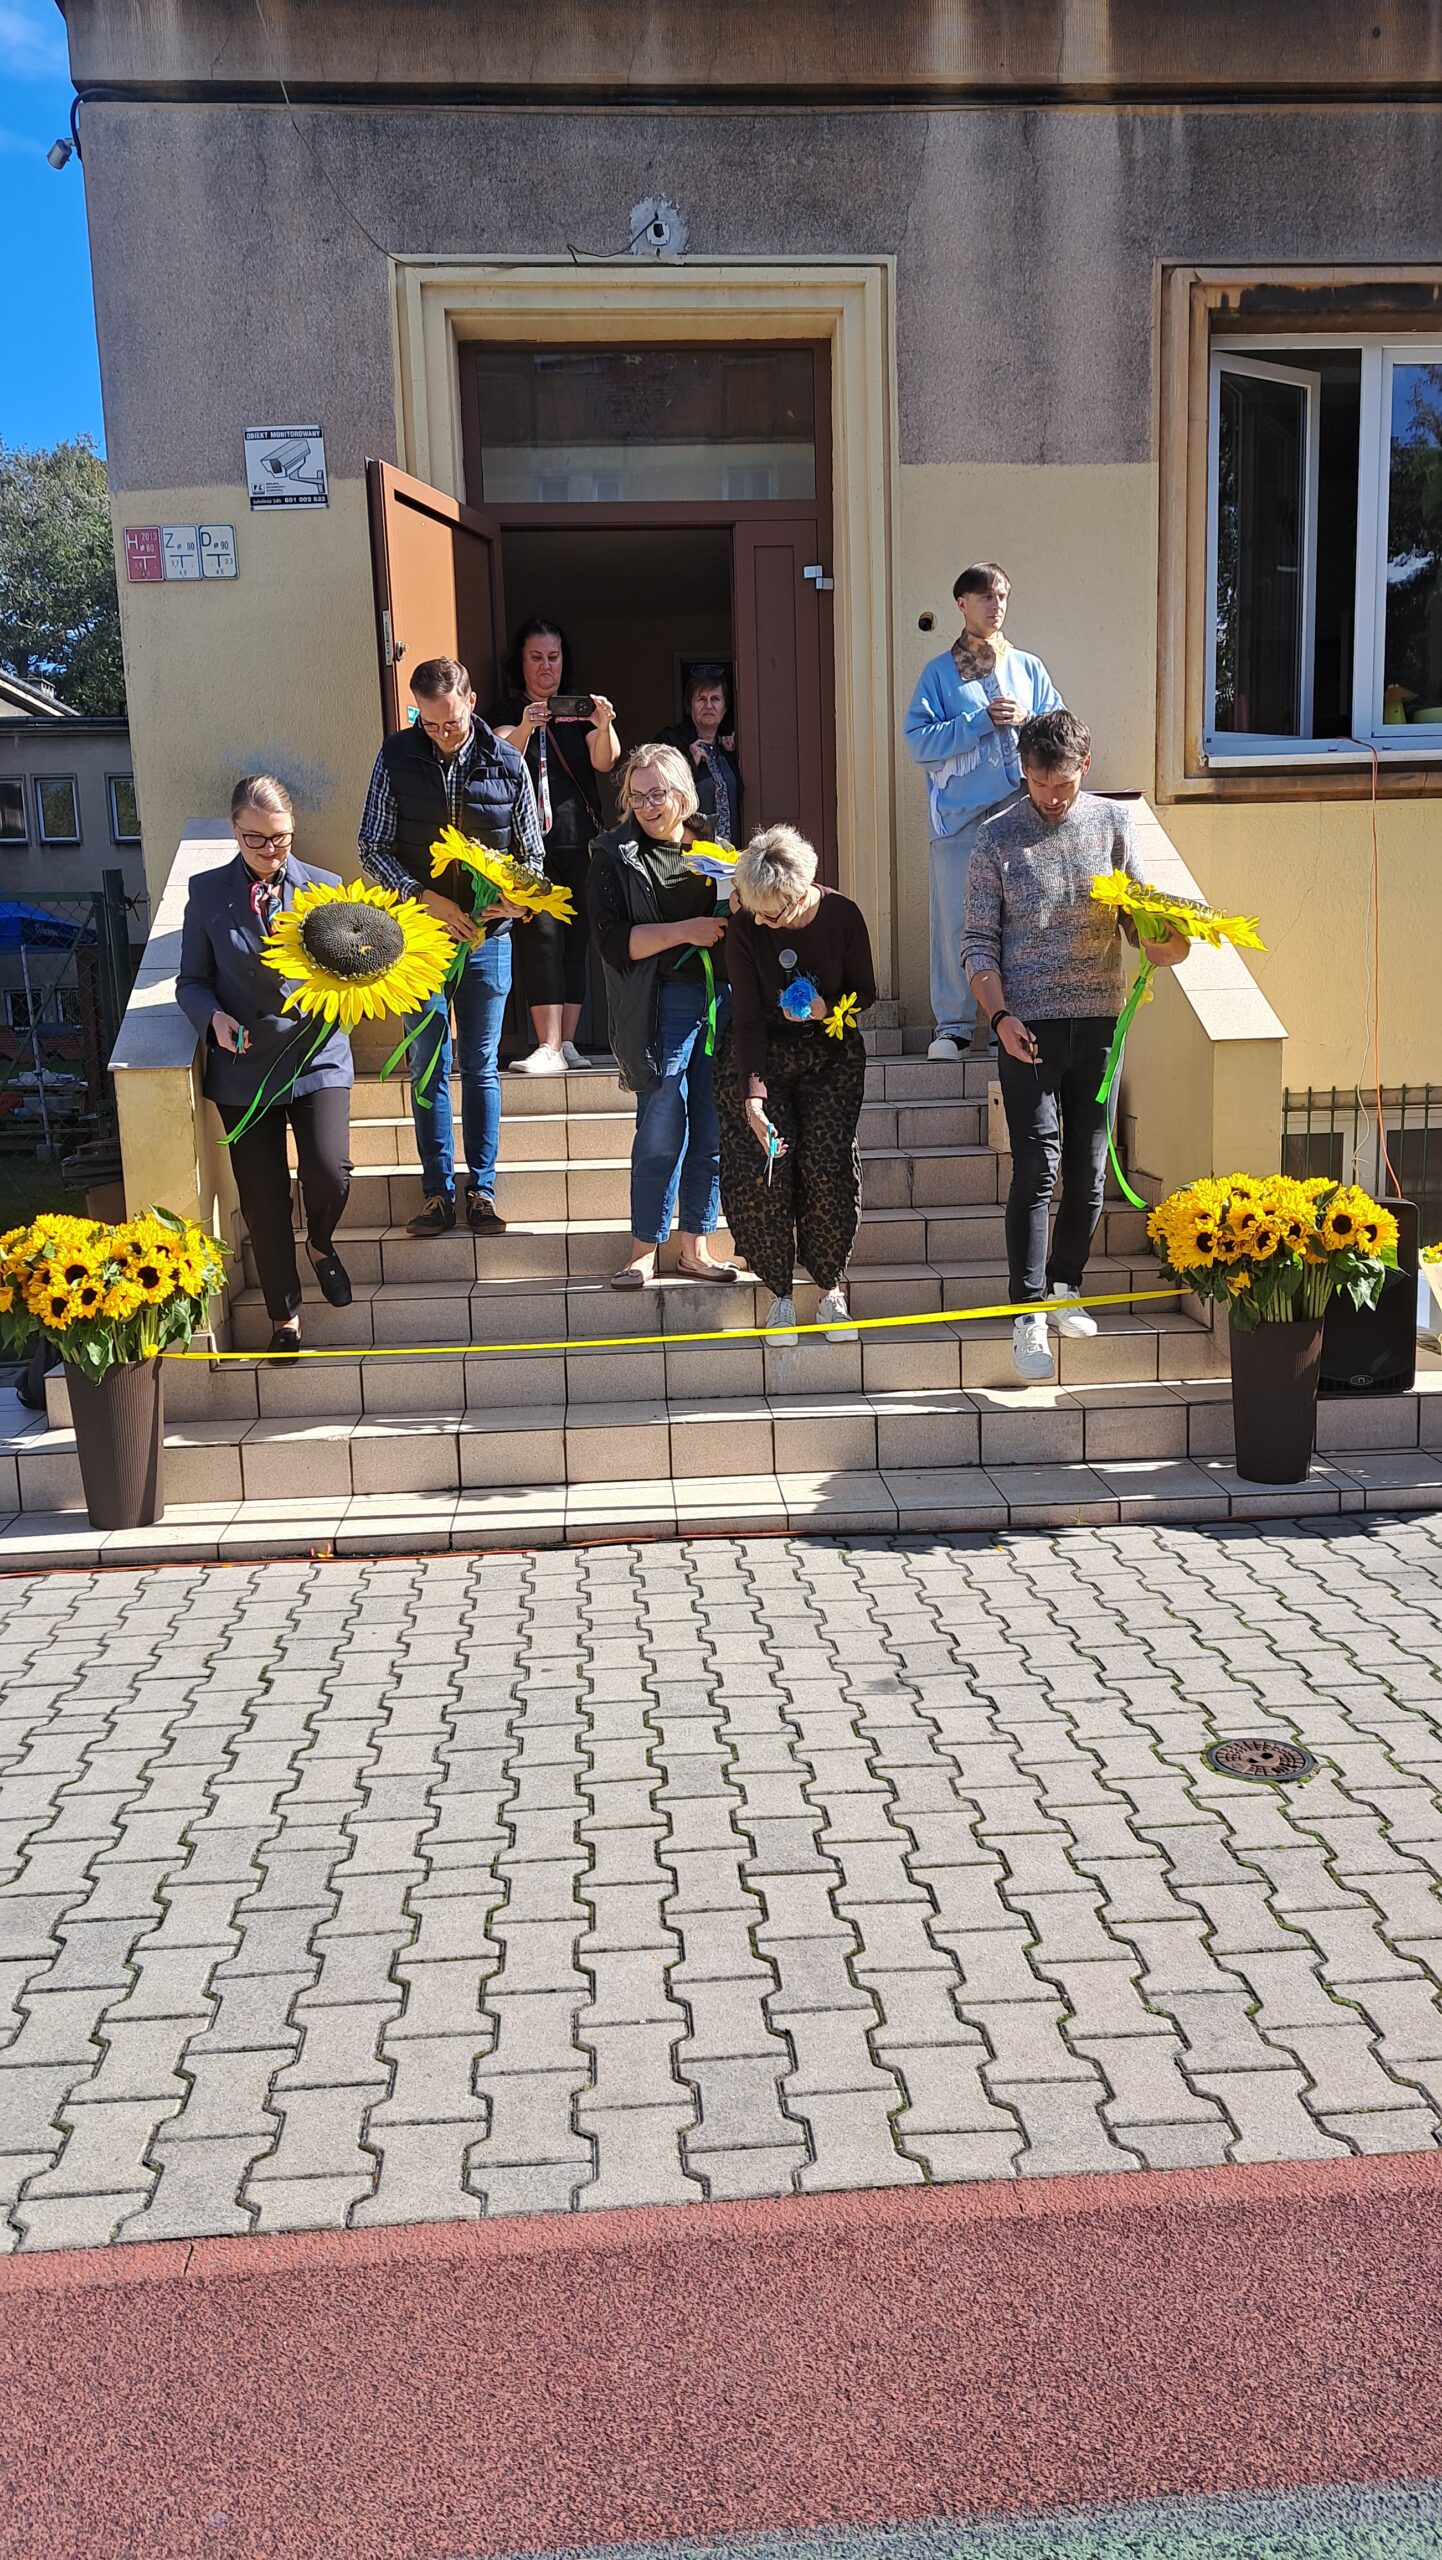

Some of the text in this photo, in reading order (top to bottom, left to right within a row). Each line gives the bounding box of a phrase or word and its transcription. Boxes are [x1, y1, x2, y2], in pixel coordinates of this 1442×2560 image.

[270, 431, 320, 439] MONITOROWANY
[127, 532, 157, 550] H 2013
[164, 533, 174, 548] Z
[201, 532, 211, 546] D
[220, 541, 229, 550] 90
